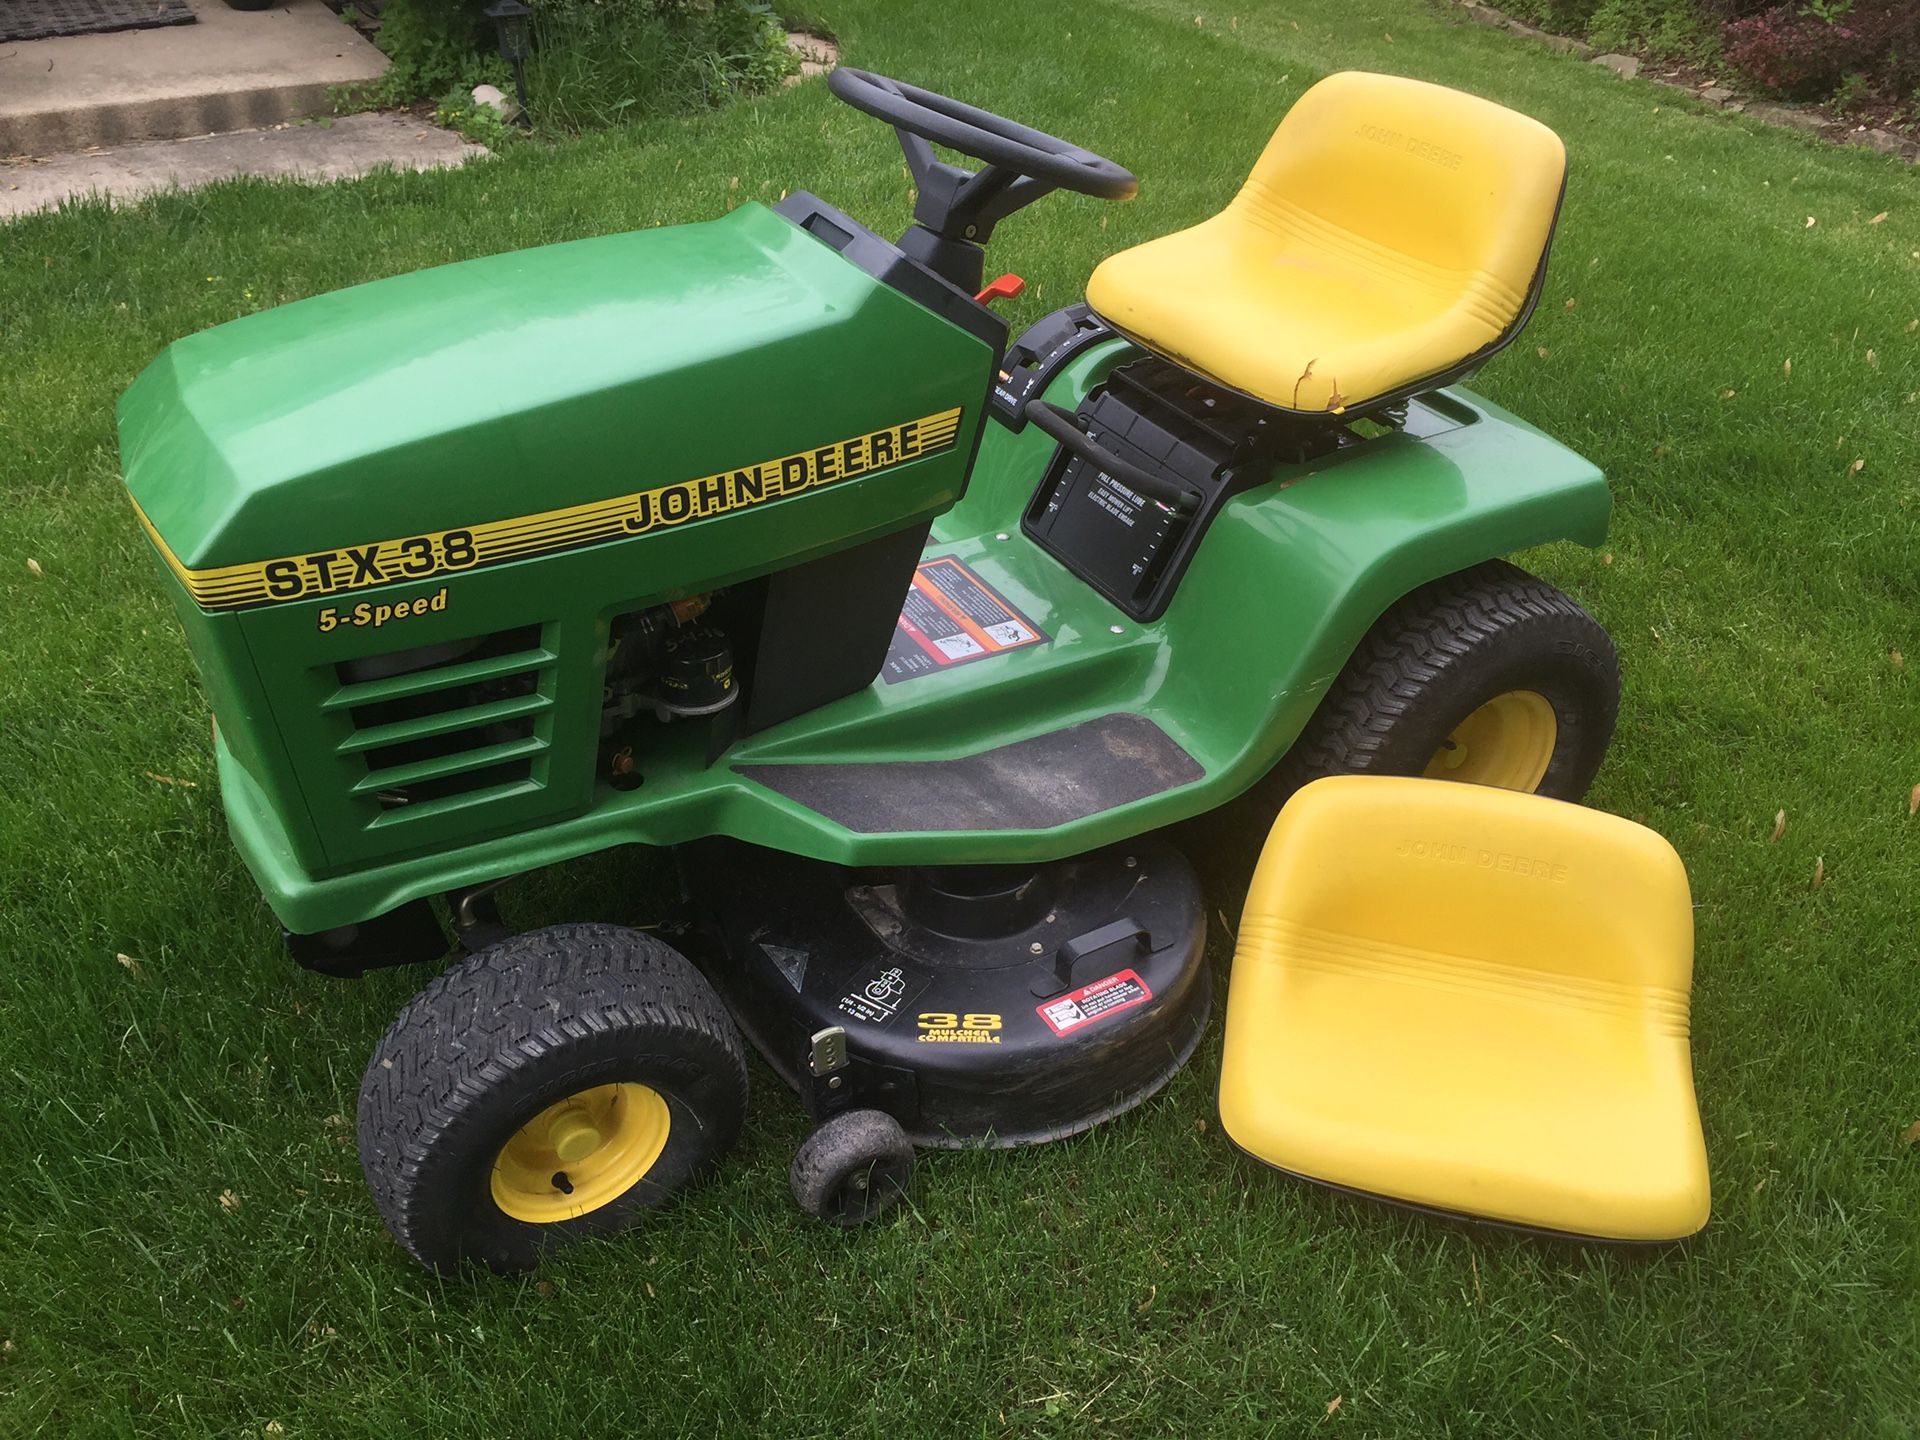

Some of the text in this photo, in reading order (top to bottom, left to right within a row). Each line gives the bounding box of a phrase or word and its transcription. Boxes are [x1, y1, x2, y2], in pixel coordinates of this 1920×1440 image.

[1353, 122, 1464, 174] JOHN DEERE
[624, 421, 921, 533] JOHN DEERE
[1098, 471, 1146, 507] FULL PRESSURE LUBE
[1087, 491, 1135, 527] ELECTRIC BLADE ENGAGE
[1097, 487, 1134, 515] EASY MOWER LIFT
[264, 529, 479, 600] STX 38
[317, 586, 449, 633] 5-Speed
[1396, 839, 1569, 884] JOHN DEERE
[1081, 982, 1127, 1003] ROTATING BLADE
[1089, 977, 1120, 993] DANGER
[847, 1007, 856, 1015] 13
[854, 1011, 867, 1021] mm
[917, 1012, 1002, 1029] 38
[917, 1034, 1000, 1044] COMPATIBLE
[929, 1029, 990, 1037] MULCHER
